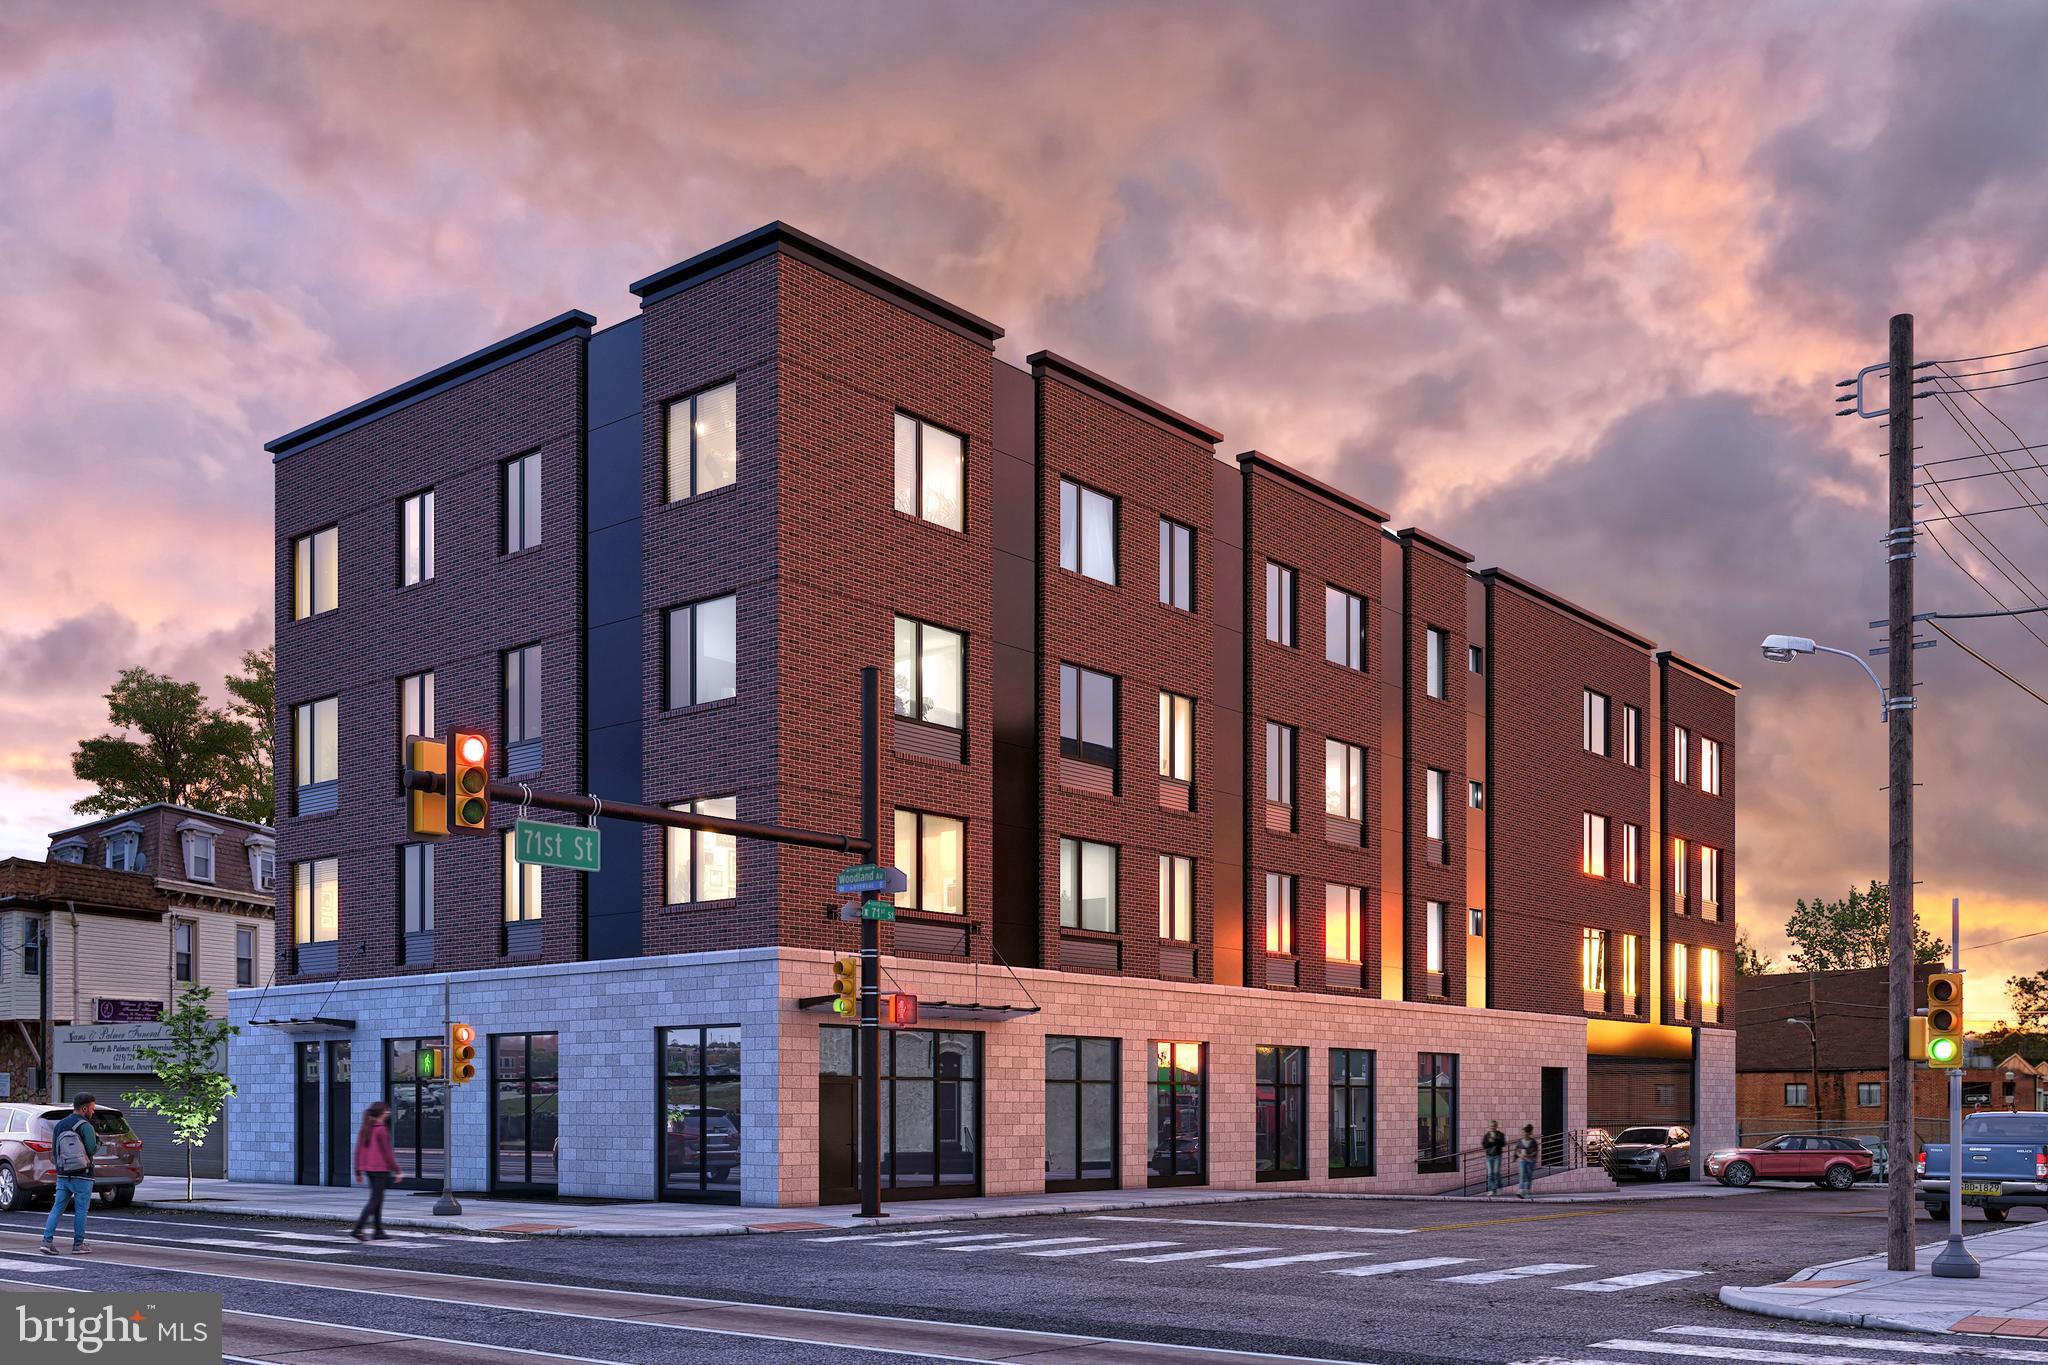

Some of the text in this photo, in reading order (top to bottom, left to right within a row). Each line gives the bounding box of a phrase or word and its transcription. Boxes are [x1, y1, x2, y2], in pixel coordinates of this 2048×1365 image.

[524, 829, 593, 862] 71st St
[838, 870, 874, 884] Woodland
[99, 1026, 125, 1040] Palmer
[128, 1024, 162, 1038] Funeral
[91, 1045, 106, 1055] Harry
[112, 1062, 121, 1071] You
